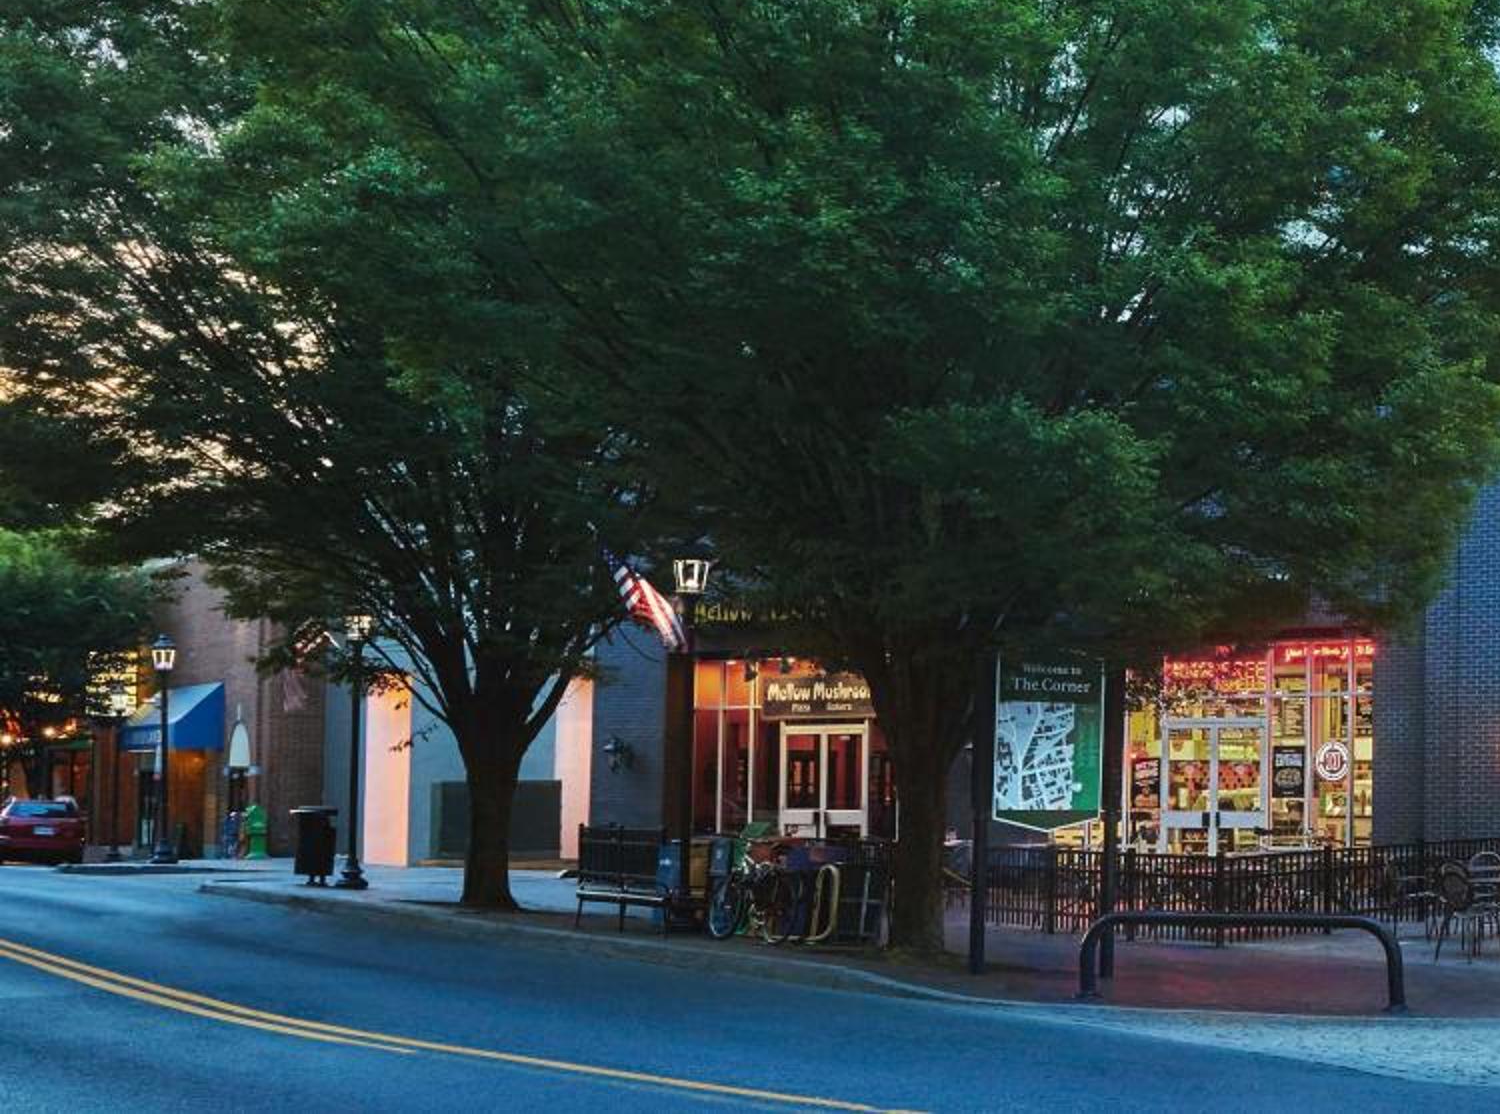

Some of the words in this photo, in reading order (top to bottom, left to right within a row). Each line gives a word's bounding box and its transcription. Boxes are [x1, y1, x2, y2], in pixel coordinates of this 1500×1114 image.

[767, 682, 811, 701] Mellow
[813, 681, 872, 701] Mushroo
[1013, 677, 1040, 691] The
[1041, 678, 1091, 693] Corner
